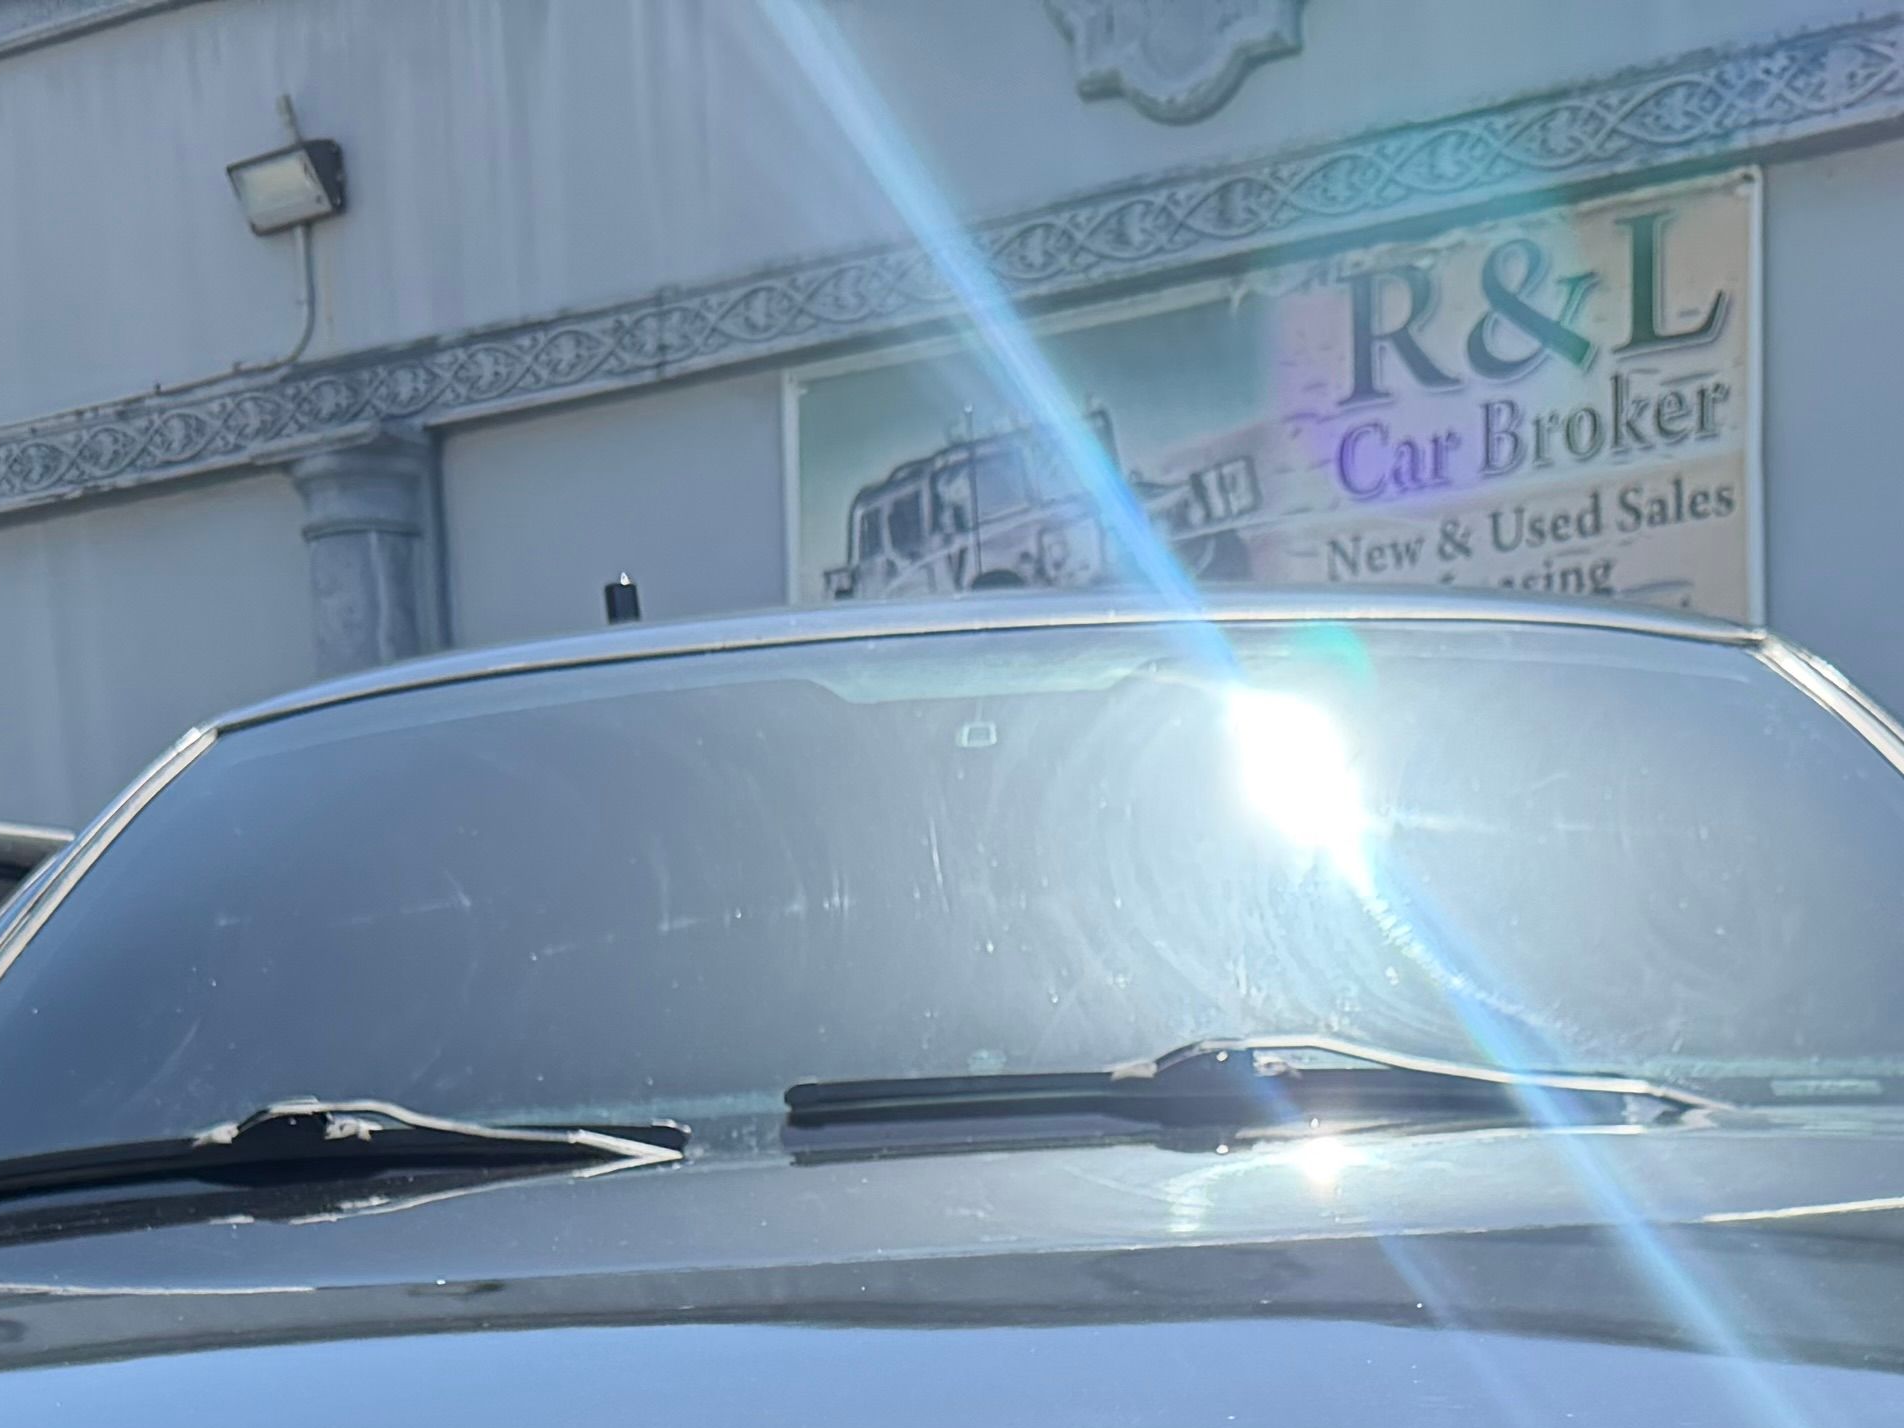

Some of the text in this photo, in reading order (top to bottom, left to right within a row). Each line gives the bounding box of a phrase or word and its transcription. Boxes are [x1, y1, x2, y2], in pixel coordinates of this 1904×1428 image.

[1337, 206, 1734, 407] R&L
[1337, 371, 1733, 500] Car Broker
[1326, 473, 1737, 582] New & Used Sales
